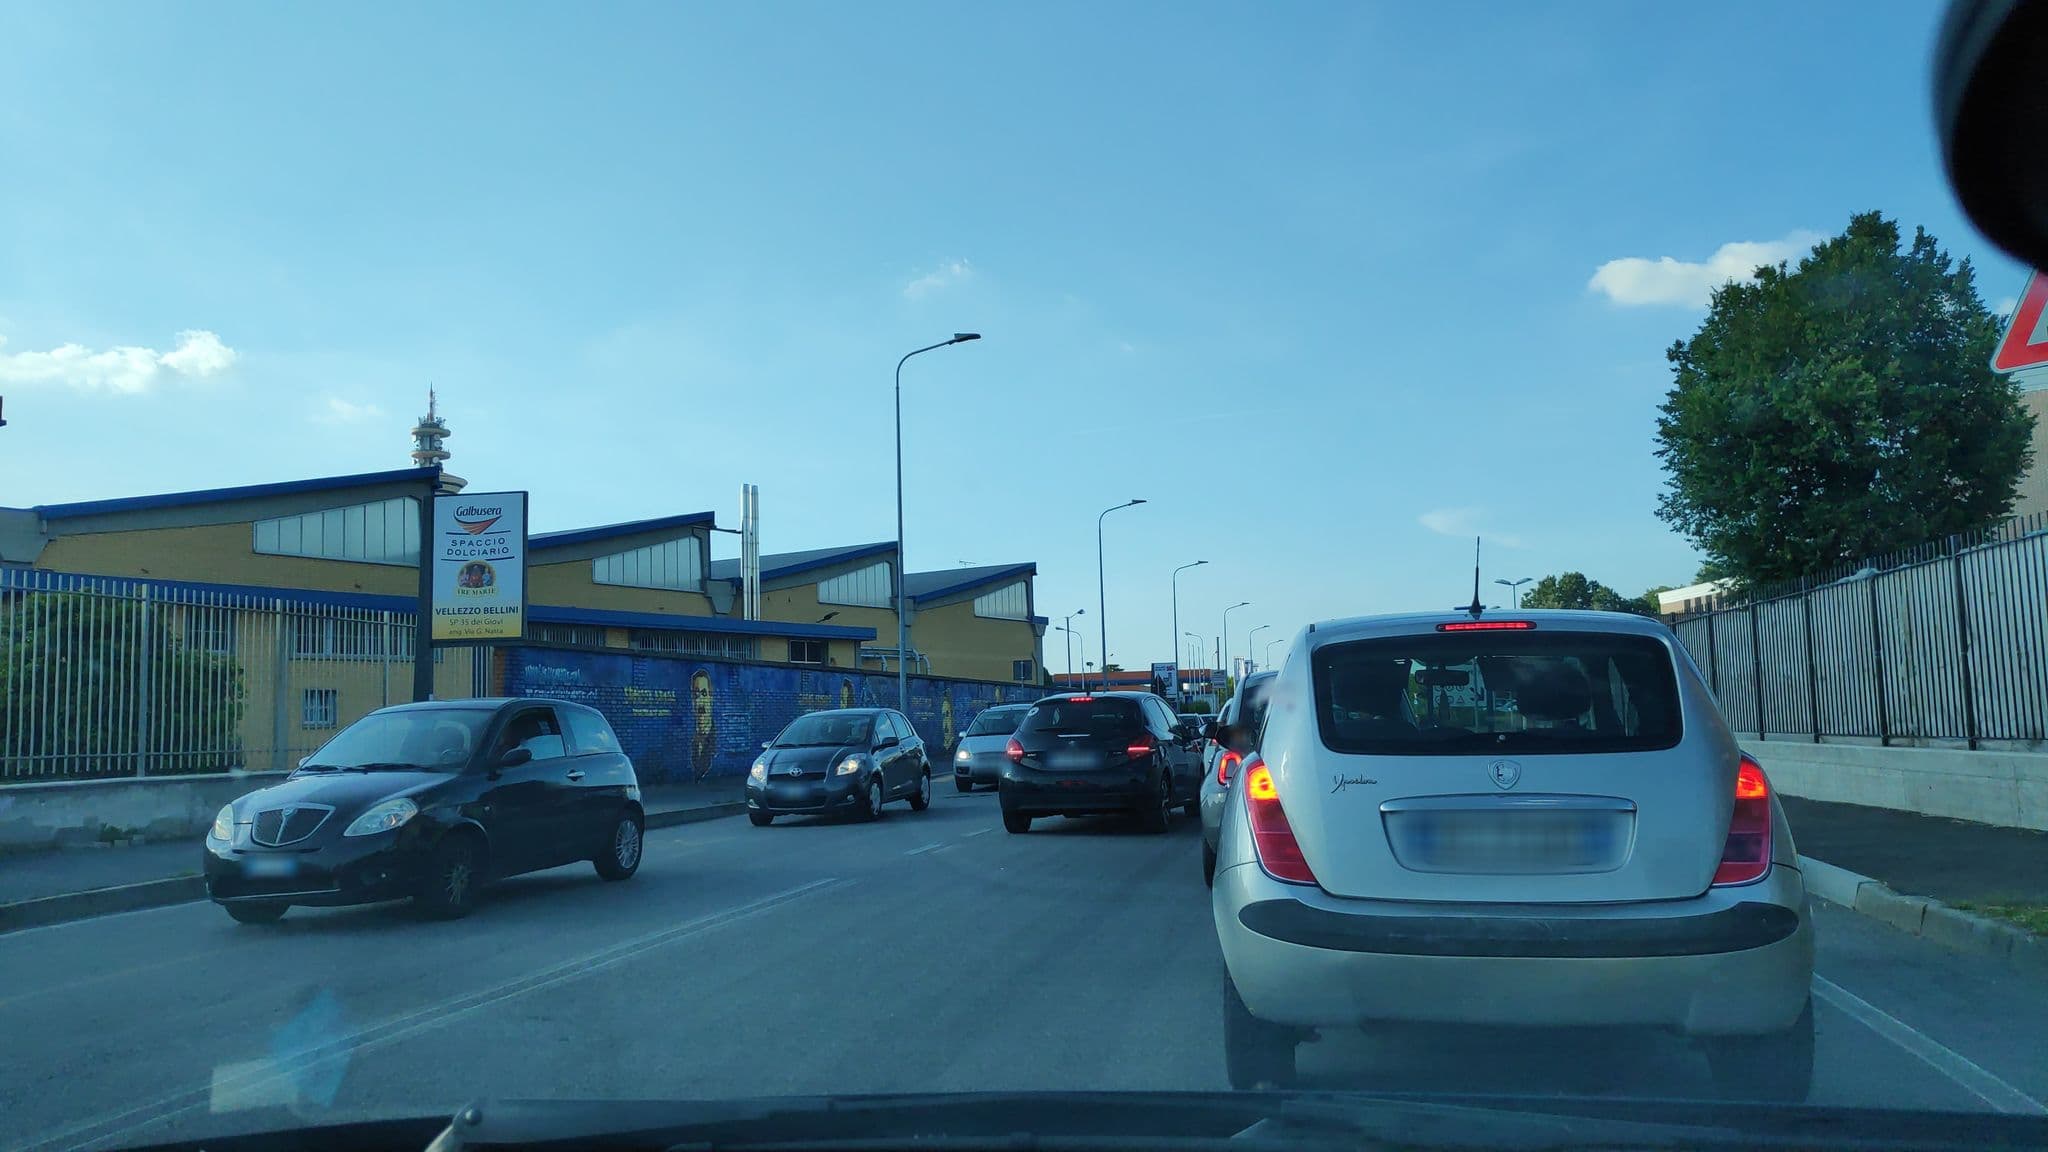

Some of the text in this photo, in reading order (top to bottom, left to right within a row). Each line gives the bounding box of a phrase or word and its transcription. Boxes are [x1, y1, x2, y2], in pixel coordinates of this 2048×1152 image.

[455, 505, 502, 517] Galbusera
[451, 537, 505, 547] SPACCIO
[447, 547, 509, 556] DOLCIARIO
[458, 588, 469, 596] TRE
[435, 606, 519, 616] VELLEZZO BELLINI
[471, 618, 483, 626] dei
